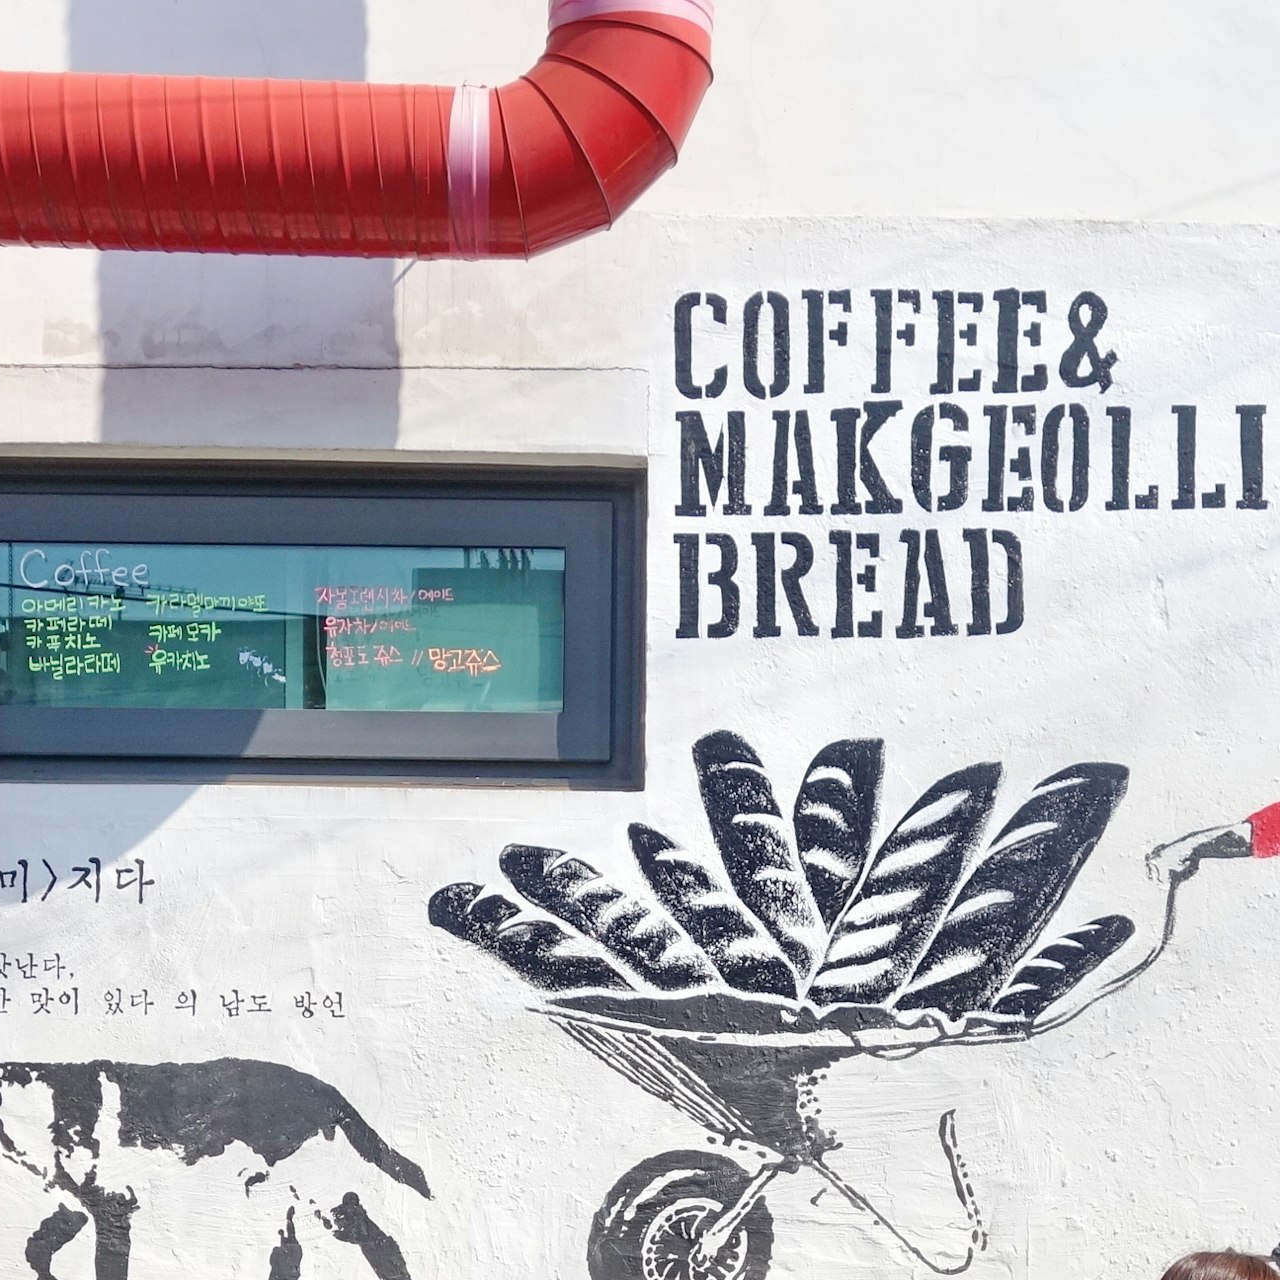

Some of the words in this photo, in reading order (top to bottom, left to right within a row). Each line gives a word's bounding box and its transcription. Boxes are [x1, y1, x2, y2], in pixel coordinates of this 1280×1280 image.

[674, 399, 1270, 517] MAKGEOLLI
[19, 548, 150, 589] Coffee
[673, 527, 1026, 640] BREAD
[30, 986, 80, 1015] 맛이
[103, 987, 155, 1016] 있다
[174, 988, 198, 1017] 의
[219, 989, 273, 1018] 남도
[293, 991, 347, 1019] 방언
